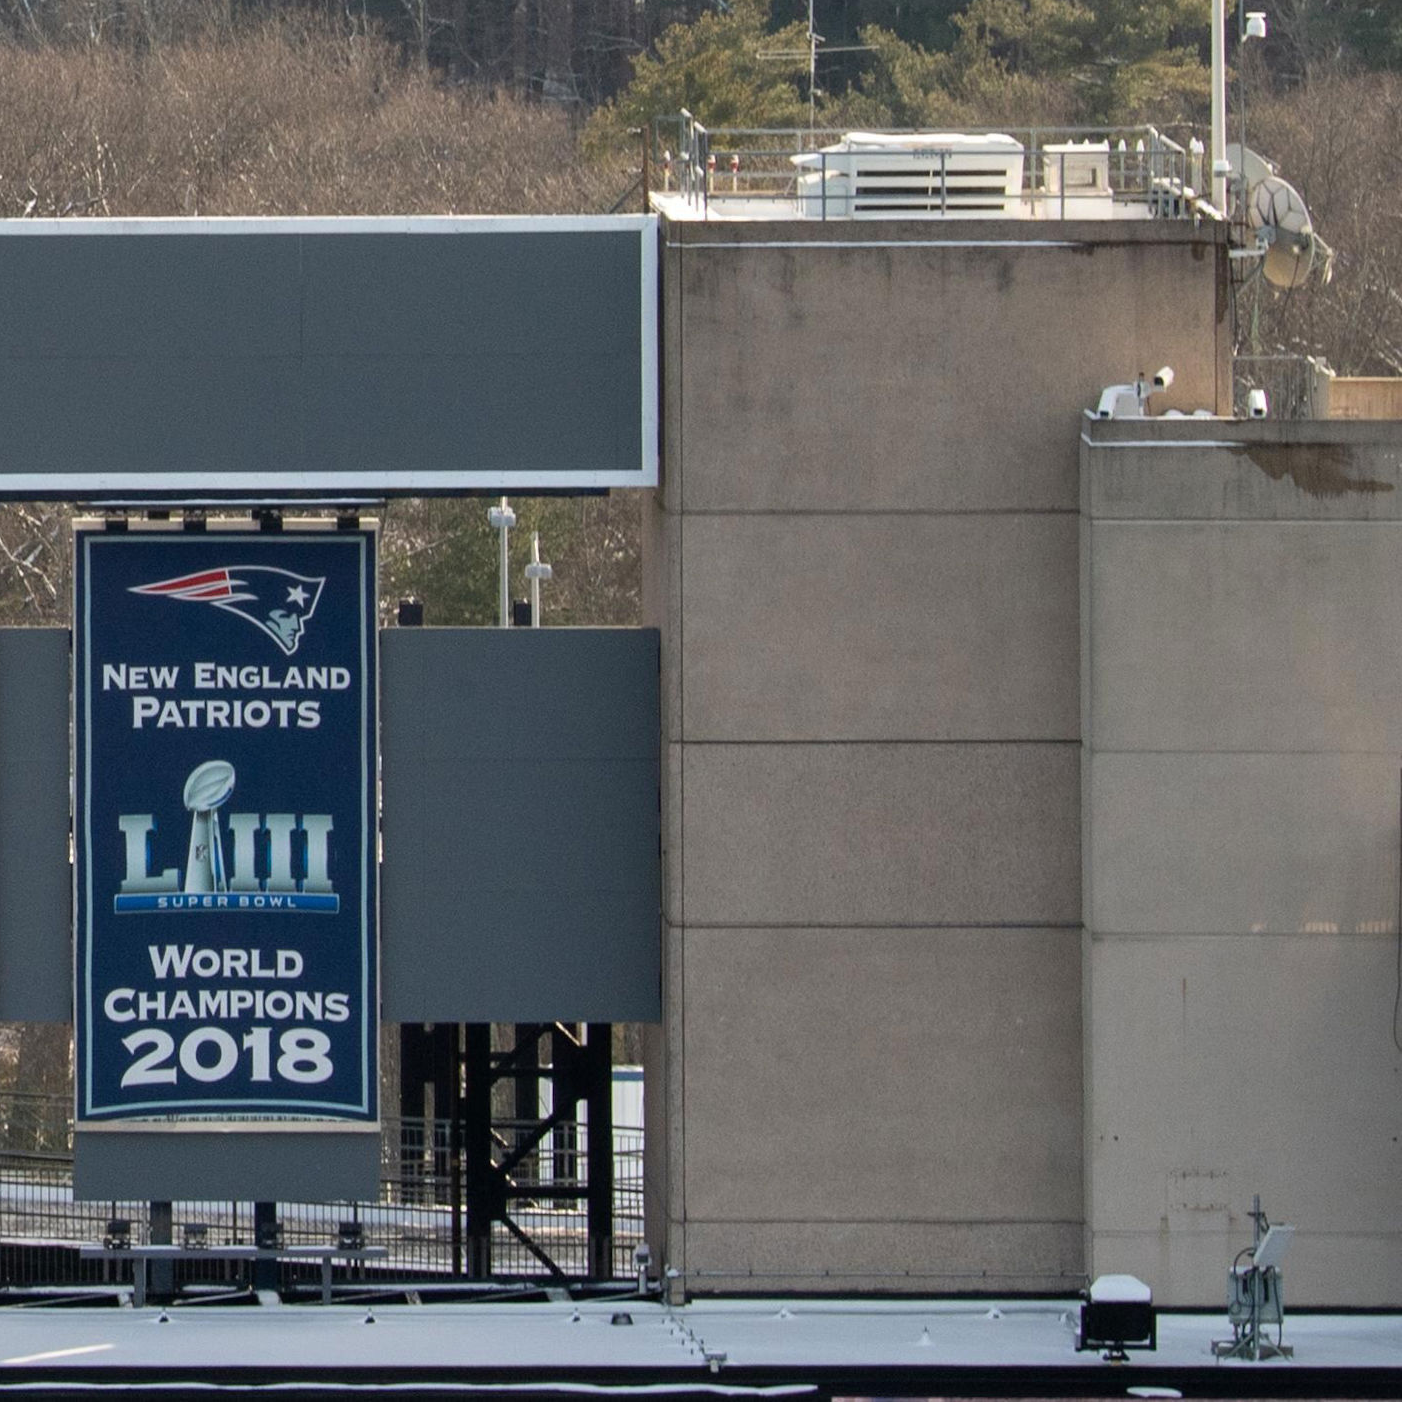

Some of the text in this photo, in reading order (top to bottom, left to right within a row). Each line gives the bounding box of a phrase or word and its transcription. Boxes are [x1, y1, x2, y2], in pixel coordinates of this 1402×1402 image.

[103, 662, 351, 691] NEW ENGLAND
[132, 696, 321, 729] PATRIOTS
[118, 813, 334, 894] LIII
[157, 896, 298, 908] SUPER BOWL
[148, 944, 304, 979] WORLD
[103, 987, 350, 1023] CHAMPIONS
[120, 1026, 334, 1088] 2018
